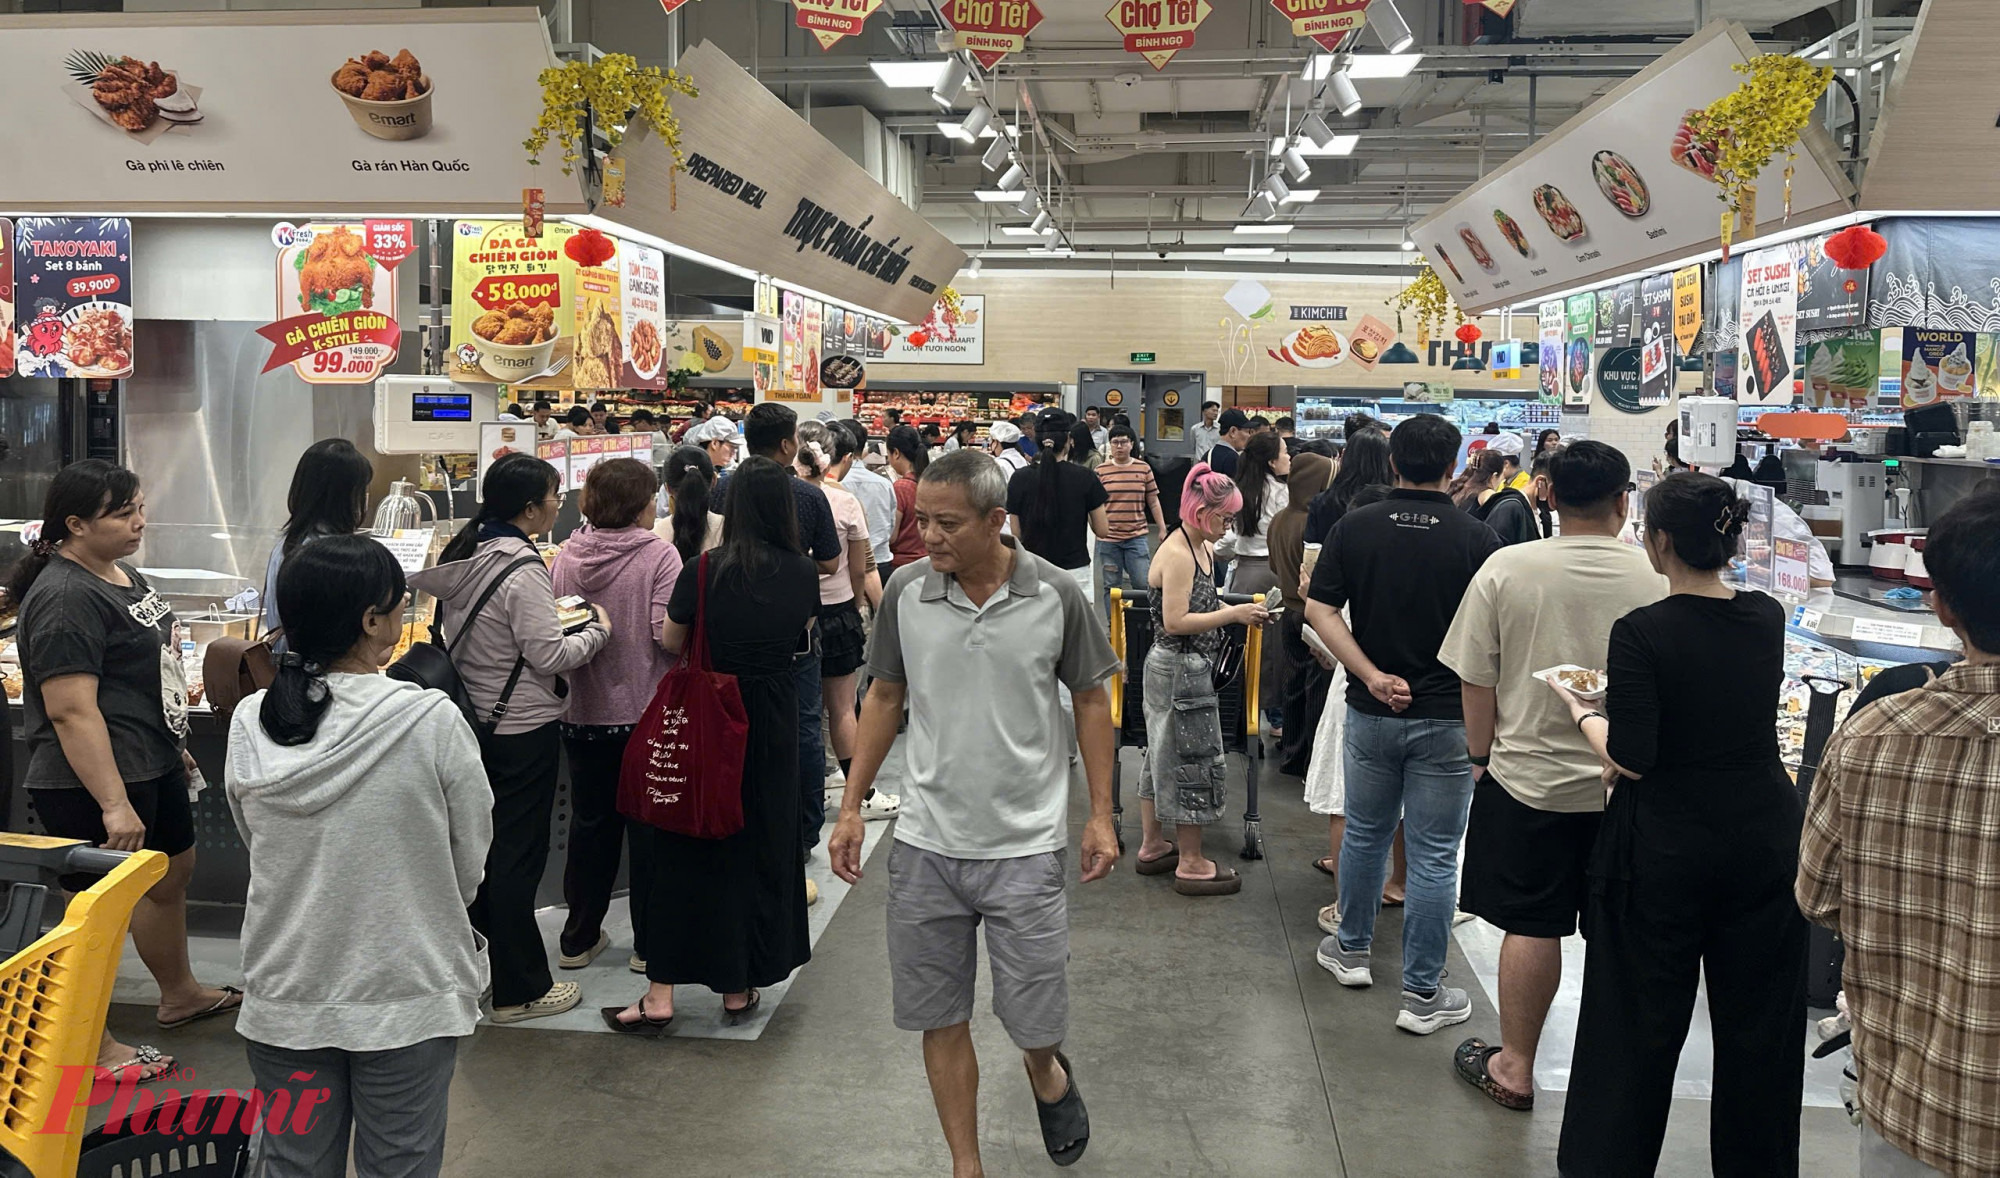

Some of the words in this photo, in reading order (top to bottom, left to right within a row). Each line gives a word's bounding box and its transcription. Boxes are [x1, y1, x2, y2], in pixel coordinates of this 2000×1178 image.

[807, 13, 830, 27] BÍNH
[831, 19, 852, 32] NGỌ
[1304, 20, 1329, 32] BÍNH
[1331, 16, 1353, 28] NGỌ
[966, 34, 990, 47] BÍNH
[991, 38, 1013, 51] NGỌ
[1135, 36, 1160, 48] BÍNH
[1161, 35, 1183, 47] NGỌ
[368, 111, 417, 126] emart
[125, 159, 146, 172] Gà
[148, 158, 170, 173] phi
[172, 158, 185, 172] lê
[187, 158, 225, 172] chiên
[351, 159, 372, 172] Gà
[374, 158, 398, 172] rán
[400, 159, 429, 172] Hàn
[431, 157, 470, 173] Quốc
[685, 151, 744, 197] PREPARED
[736, 180, 768, 210] MEAL
[554, 227, 574, 235] emart
[782, 196, 839, 253] THỰC
[856, 236, 901, 277] CHẾ
[31, 239, 118, 258] TAKOYAKI
[373, 233, 407, 249] 33%
[489, 238, 513, 250] DA
[468, 249, 517, 264] CHIÊN
[45, 260, 64, 272] Set
[65, 260, 74, 271] 8
[75, 259, 103, 272] bánh
[1746, 267, 1763, 285] SET
[1764, 261, 1791, 282] SUSHI
[1301, 306, 1338, 320] KIMCHI
[285, 325, 307, 347] GÀ
[307, 315, 350, 339] CHIÊN
[1915, 332, 1964, 342] WORLD
[312, 332, 360, 352] K-STYLE
[313, 350, 374, 374] 99.000
[493, 354, 537, 368] emart
[1603, 370, 1619, 381] KHU
[1620, 370, 1637, 384] VỰC
[1777, 571, 1807, 593] 168.000
